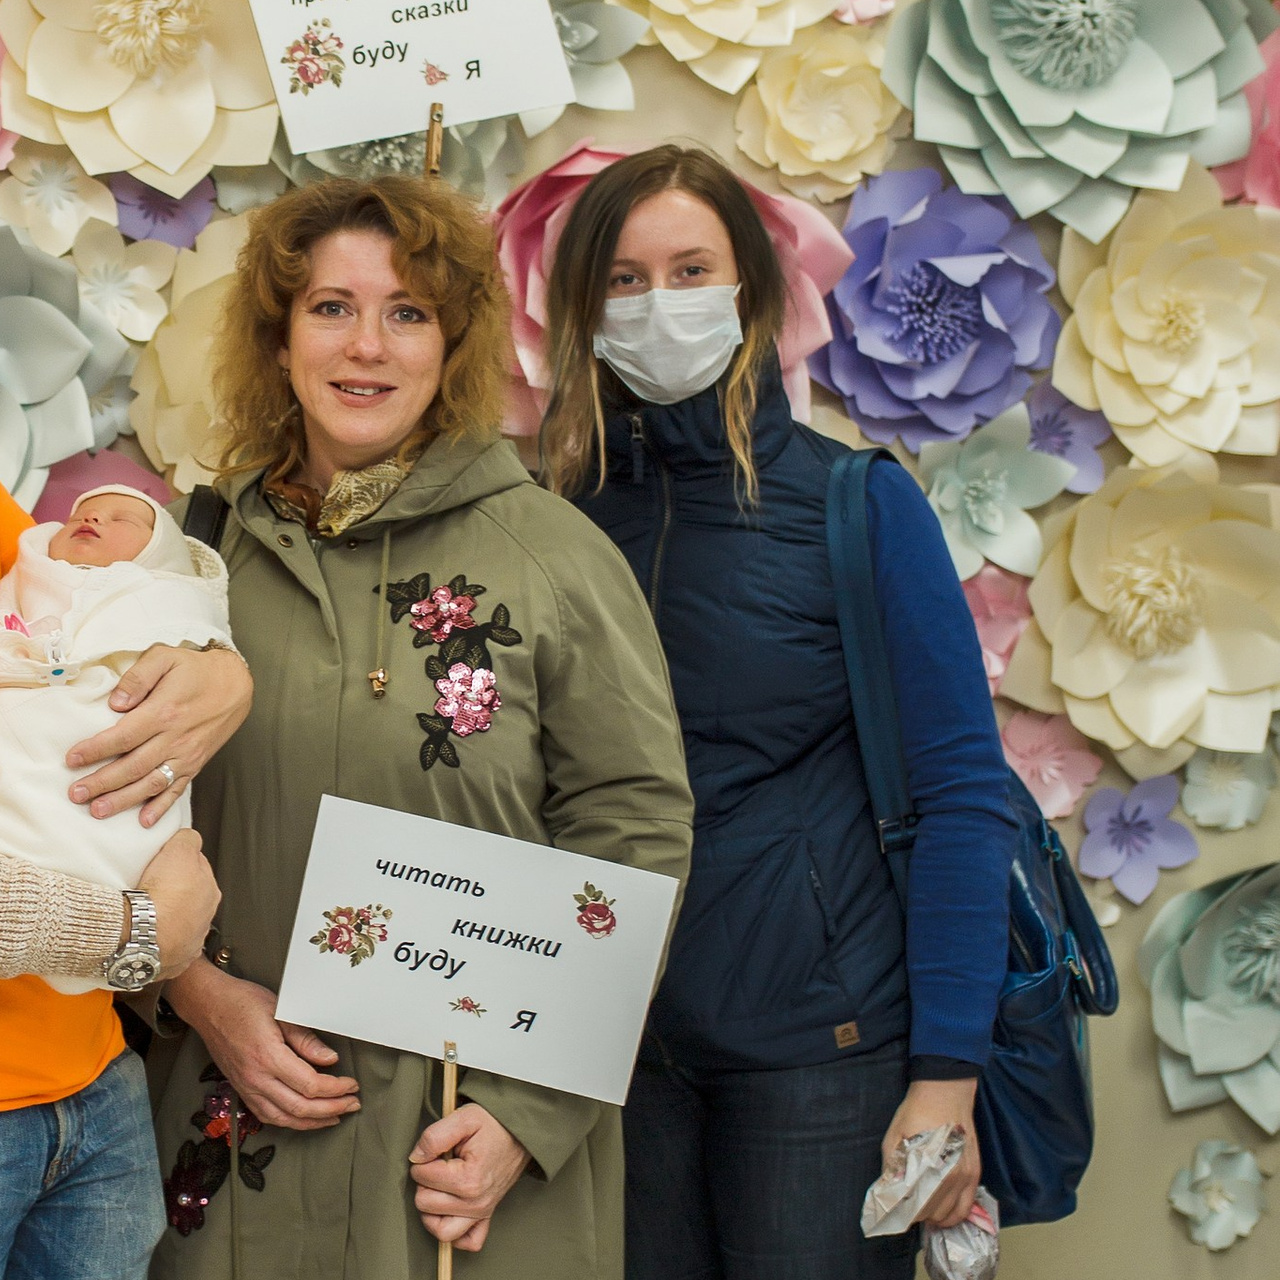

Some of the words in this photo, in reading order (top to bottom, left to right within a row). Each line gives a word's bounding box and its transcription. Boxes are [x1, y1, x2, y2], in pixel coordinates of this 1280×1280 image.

[352, 40, 409, 68] буду
[375, 858, 486, 898] читать
[450, 918, 563, 959] книжки
[393, 940, 467, 980] буду
